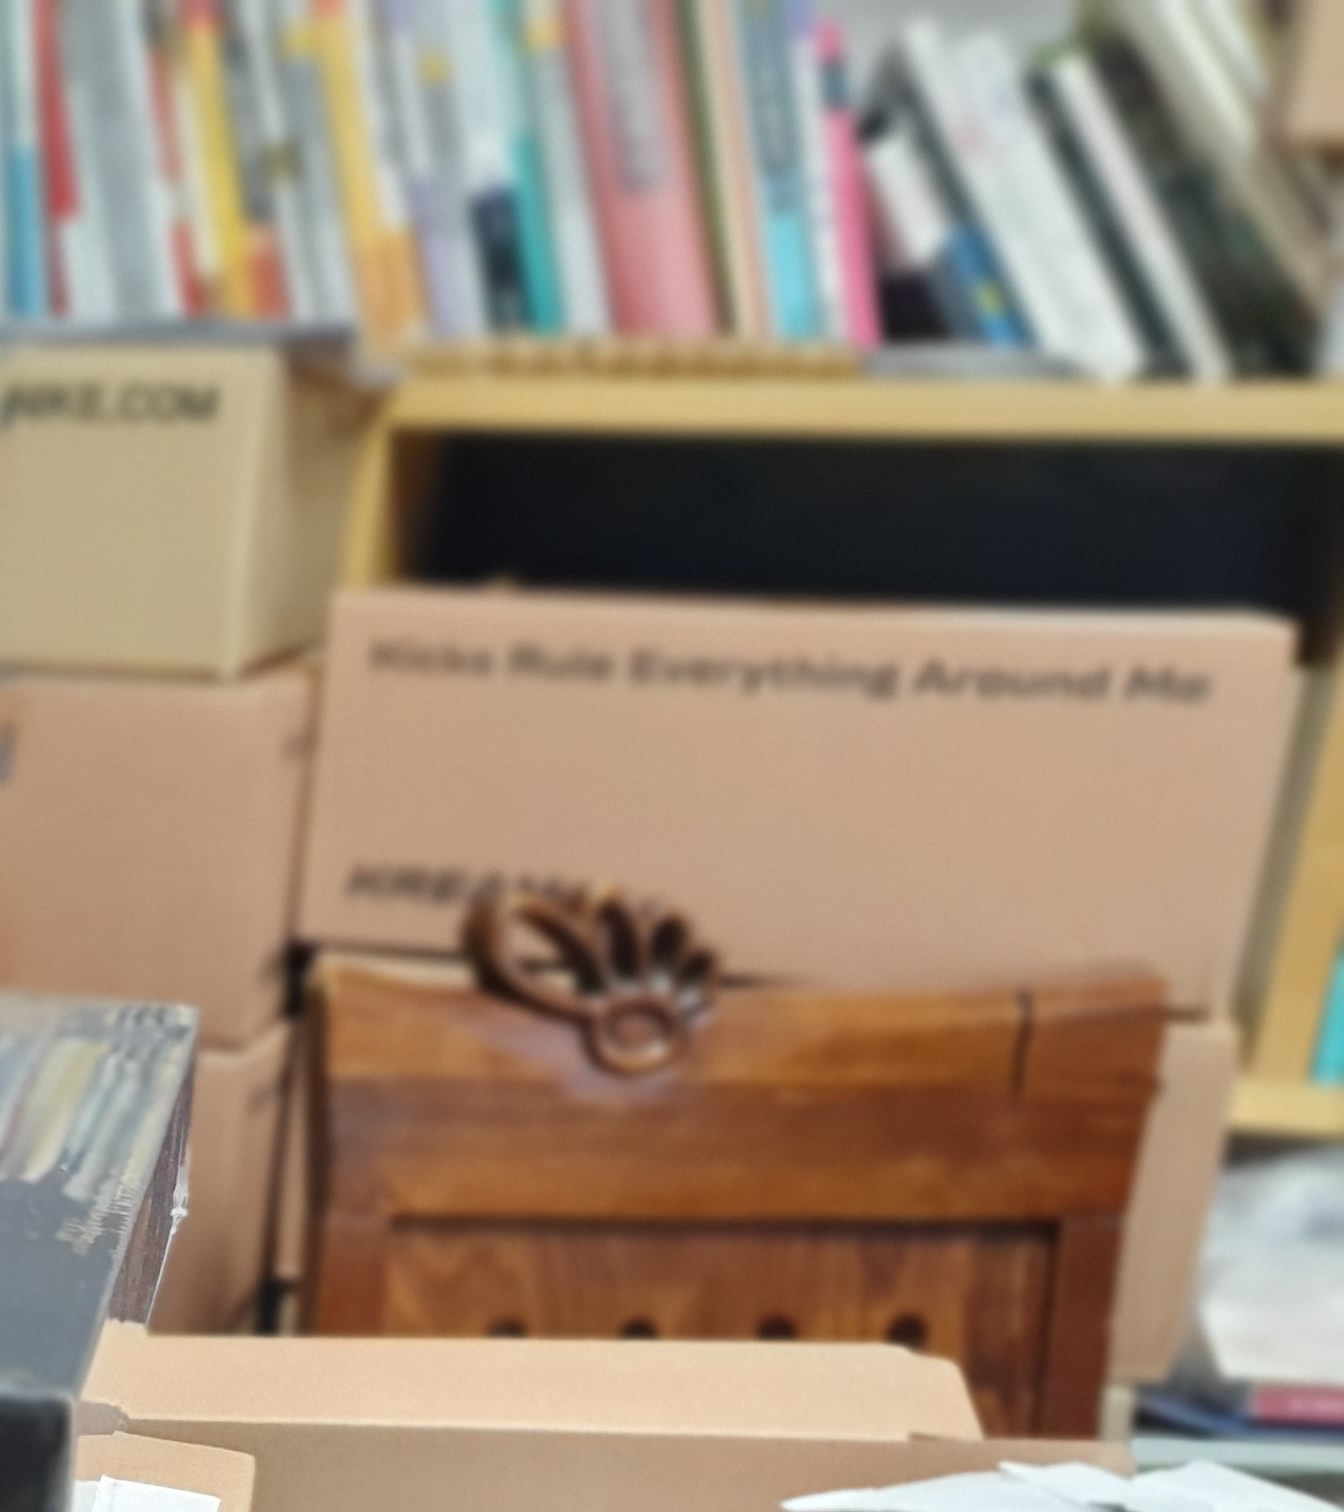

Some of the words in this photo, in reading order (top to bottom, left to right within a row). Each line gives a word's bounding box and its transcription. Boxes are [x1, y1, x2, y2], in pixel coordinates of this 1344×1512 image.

[510, 642, 612, 681] Rule
[630, 646, 897, 700] Everything
[914, 656, 1110, 700] Around
